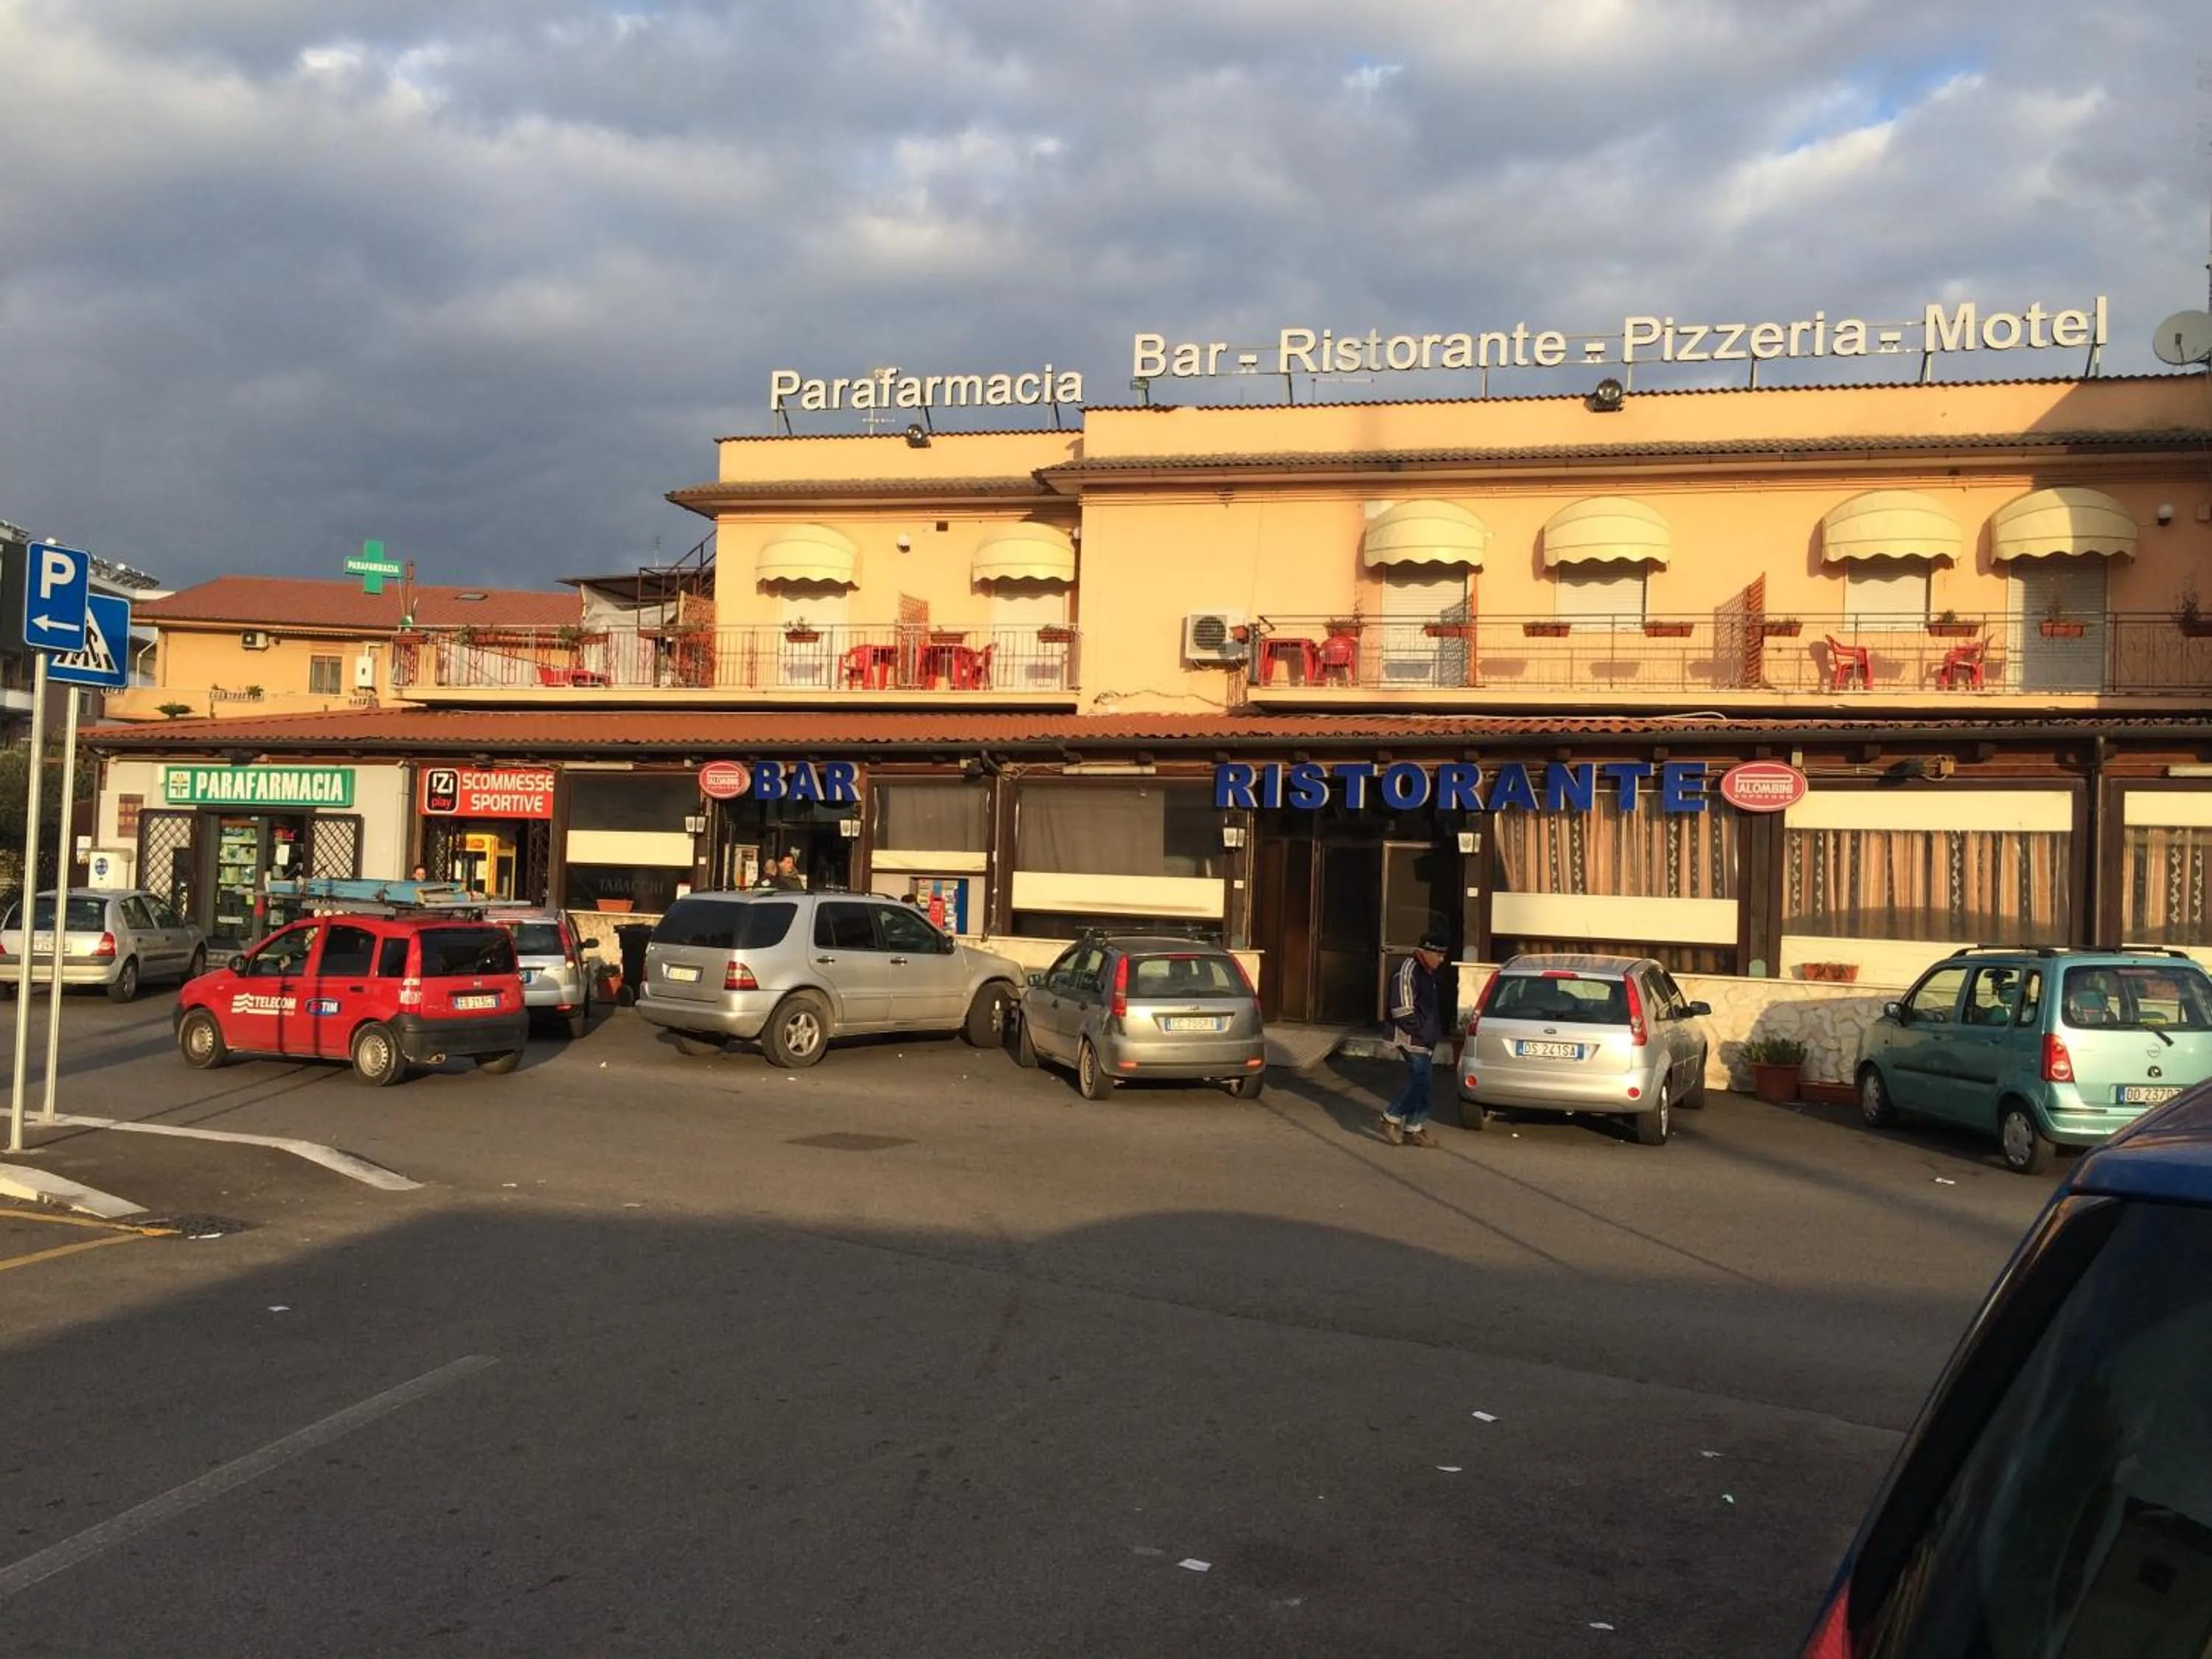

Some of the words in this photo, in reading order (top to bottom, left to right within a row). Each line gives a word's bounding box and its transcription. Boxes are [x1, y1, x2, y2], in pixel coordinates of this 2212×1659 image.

[1134, 333, 1227, 378] Bar
[1279, 321, 1567, 374] Ristorante
[1624, 310, 1868, 363] Pizzeria
[1924, 296, 2107, 352] Motel
[771, 364, 1083, 411] Parafarmacia
[41, 550, 76, 599] P
[347, 560, 399, 573] PARAFARMACIA
[195, 771, 344, 801] PARAFARMACIA
[462, 772, 554, 792] SCOMMESSE
[754, 760, 862, 801] BAR
[1215, 762, 1708, 813] RISTORANTE
[471, 793, 543, 813] SPORTIVE
[255, 996, 296, 1009] TELECOM
[321, 1002, 338, 1012] TIM
